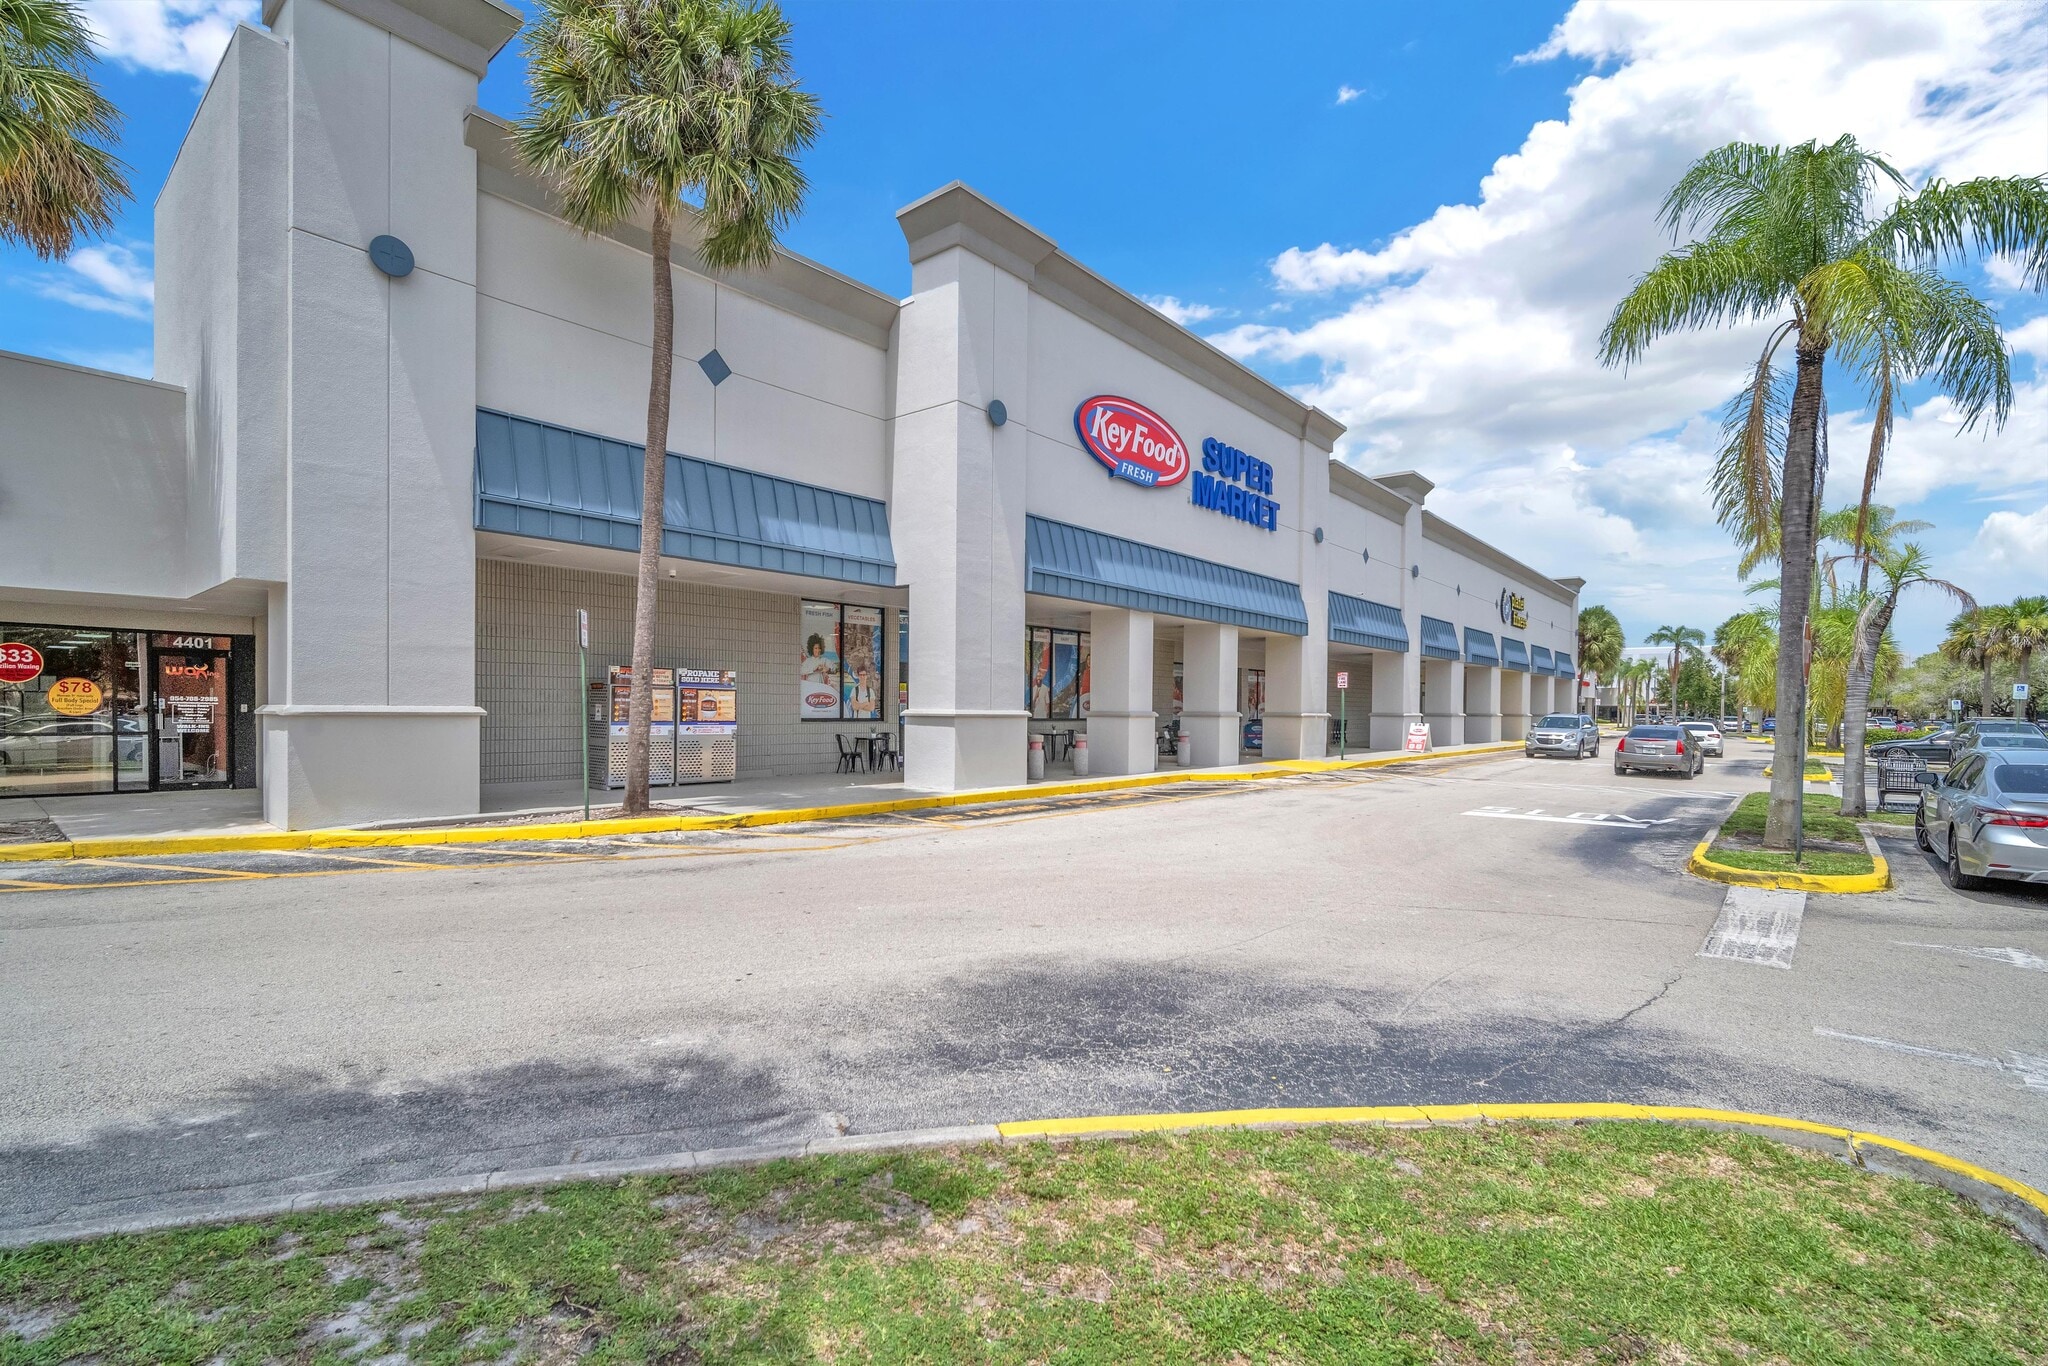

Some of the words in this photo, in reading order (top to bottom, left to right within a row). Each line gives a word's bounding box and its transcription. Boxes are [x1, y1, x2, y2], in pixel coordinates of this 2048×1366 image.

[1091, 406, 1133, 453] Key
[1132, 423, 1180, 468] Food
[1121, 462, 1154, 483] FRESH
[1202, 436, 1274, 496] SUPER
[1192, 470, 1281, 532] MARKET
[847, 614, 876, 622] VEGETABLES
[172, 636, 213, 649] 4401
[59, 681, 92, 694] $78
[807, 695, 819, 704] Key
[819, 695, 834, 704] Food
